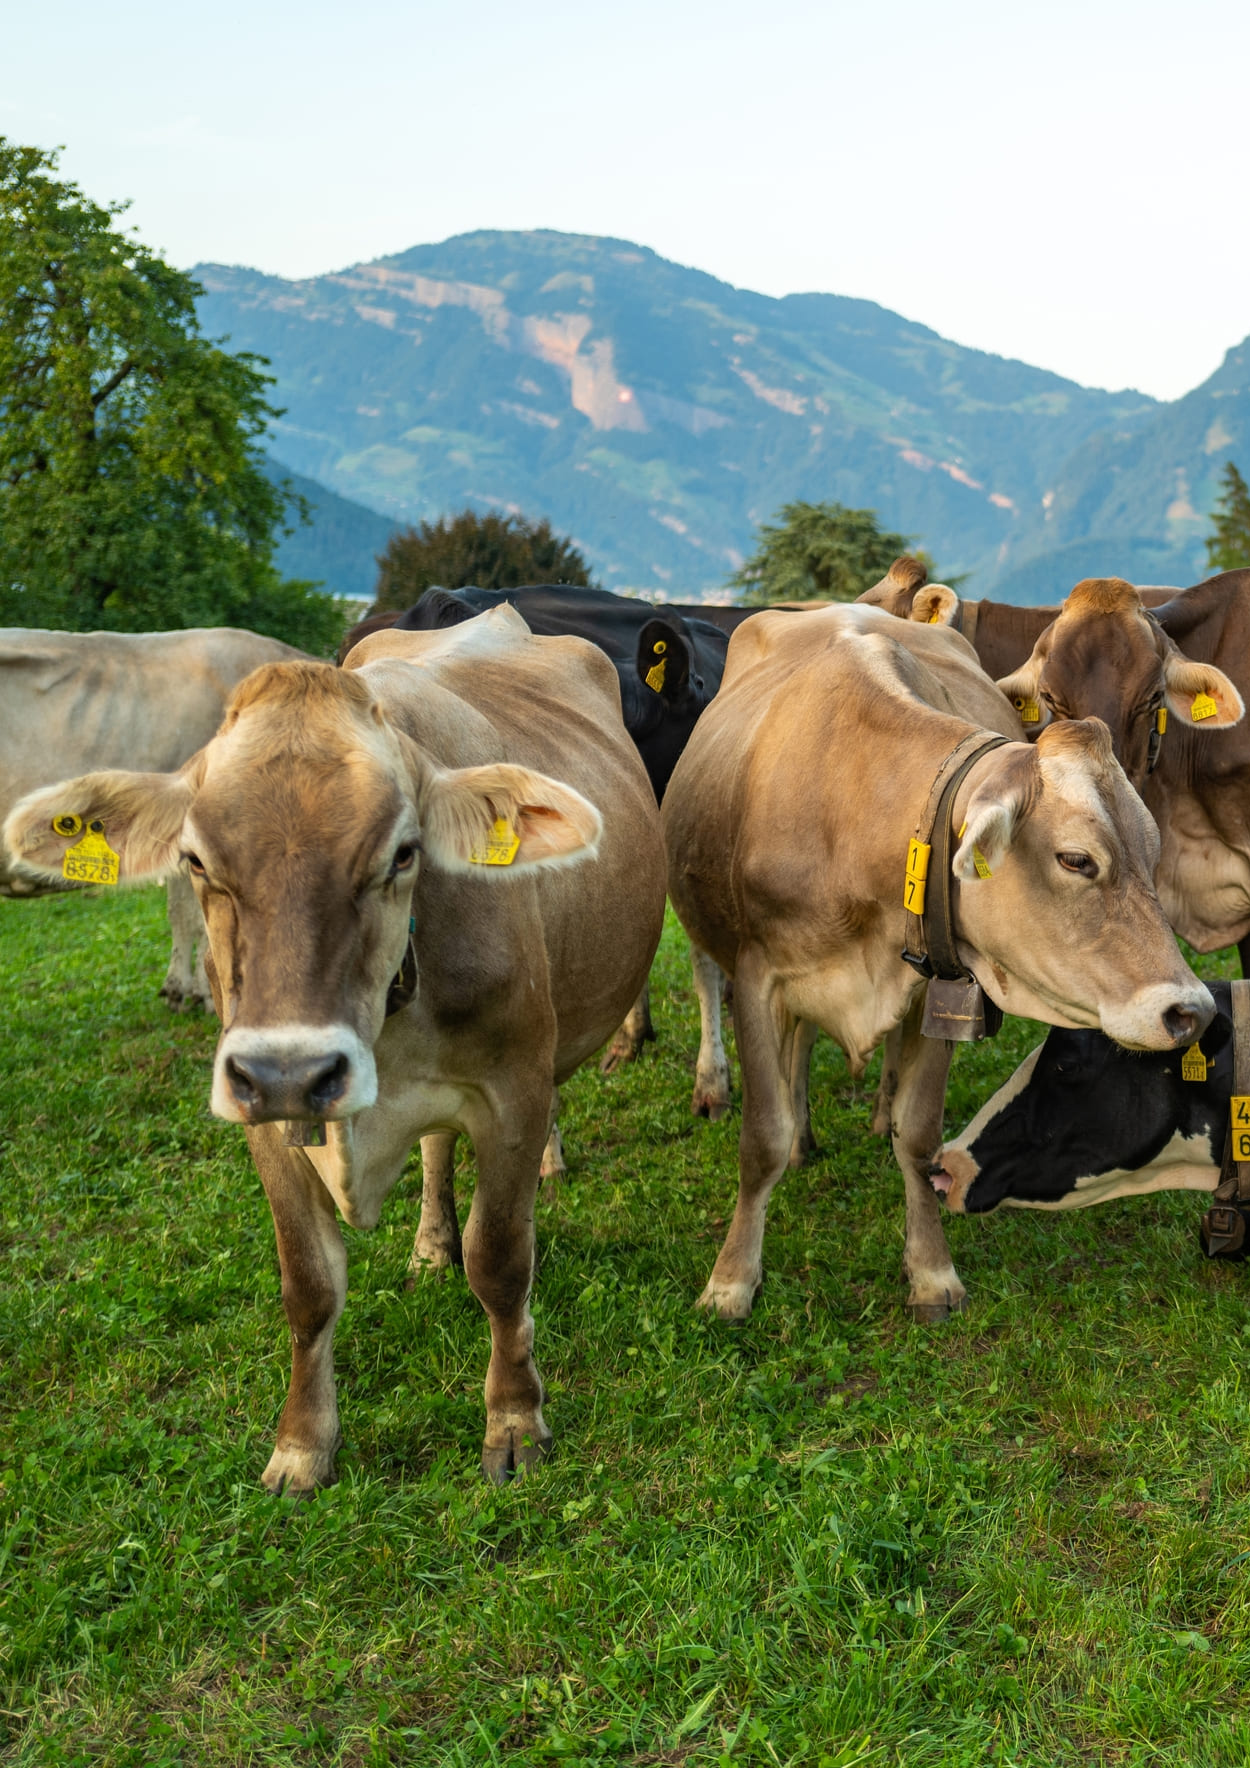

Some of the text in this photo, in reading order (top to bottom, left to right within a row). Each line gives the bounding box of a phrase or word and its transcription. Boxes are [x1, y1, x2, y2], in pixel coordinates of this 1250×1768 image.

[912, 847, 918, 872] 1
[908, 880, 917, 905] 7
[1237, 1101, 1250, 1125] 4
